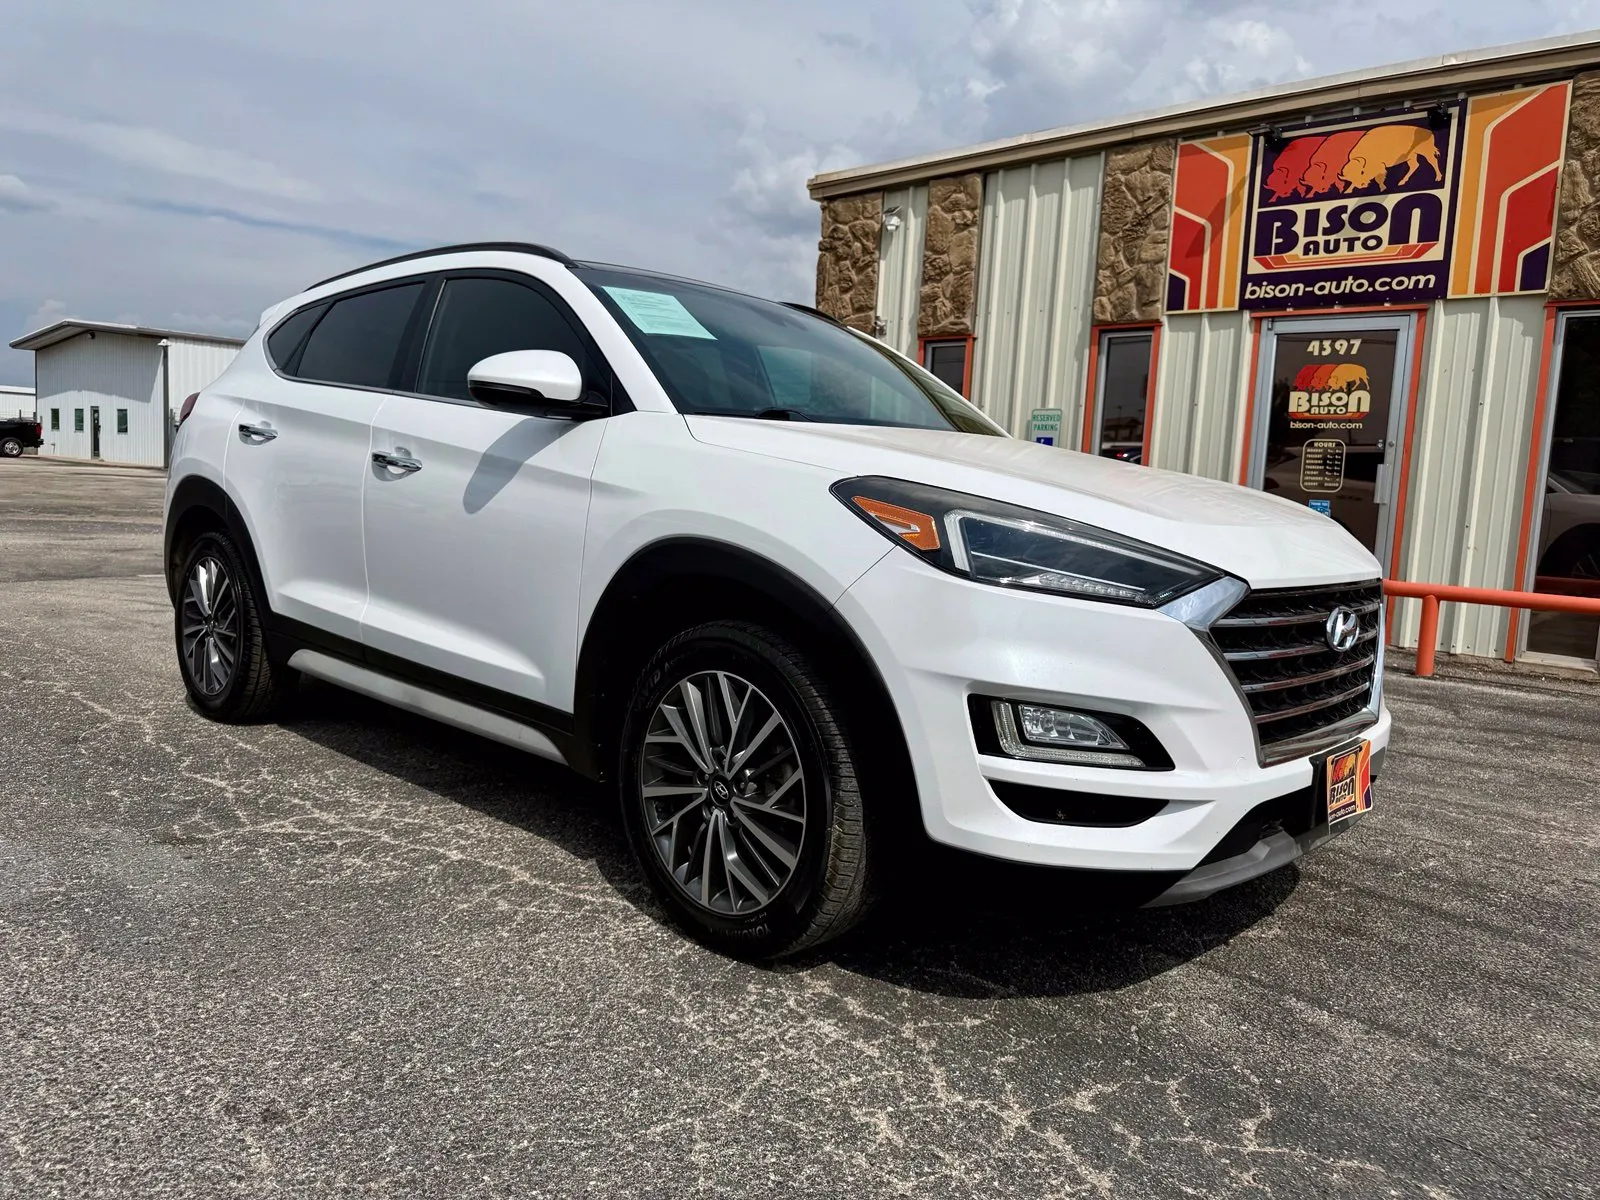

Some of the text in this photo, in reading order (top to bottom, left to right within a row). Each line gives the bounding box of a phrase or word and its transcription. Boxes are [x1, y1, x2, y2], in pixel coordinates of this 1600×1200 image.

[1254, 193, 1442, 256] BISON
[1303, 235, 1383, 256] AUTO
[1244, 273, 1436, 299] bison-auto.com
[1307, 339, 1362, 356] 4397
[1288, 390, 1371, 413] BISON
[1311, 406, 1346, 414] AUTO
[1034, 423, 1058, 431] PARKING
[1290, 421, 1363, 429] bison-auto.com
